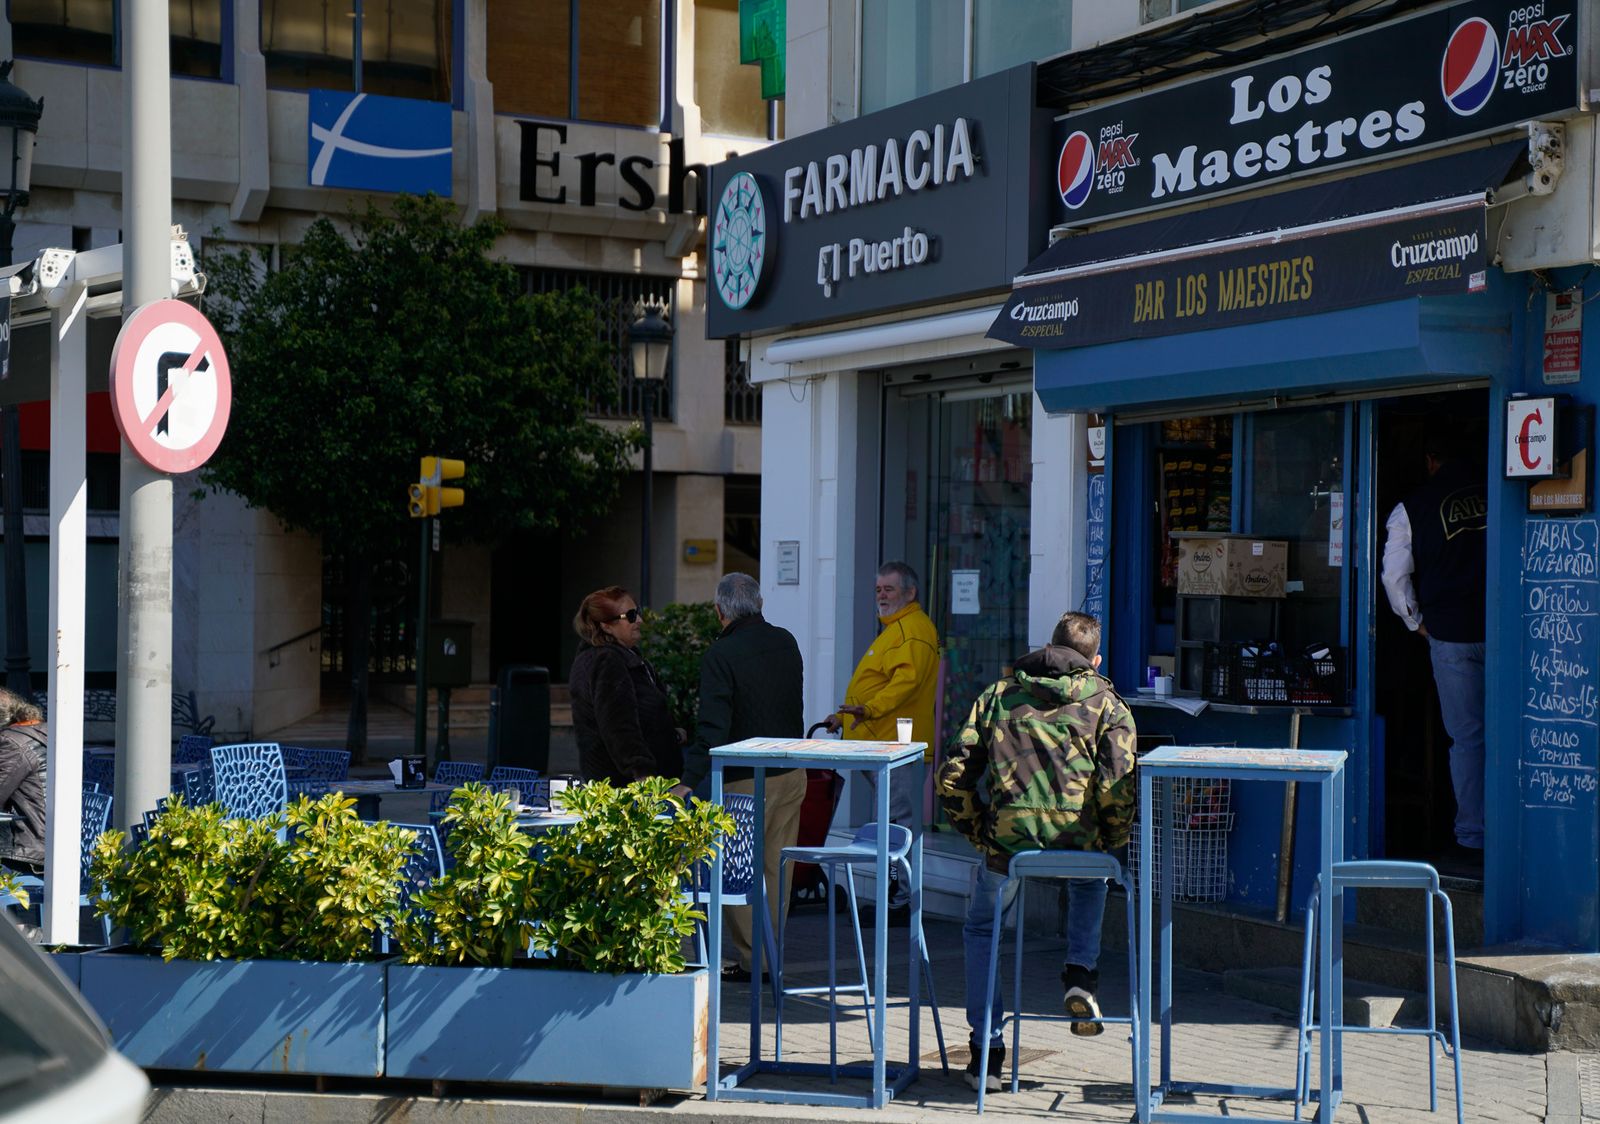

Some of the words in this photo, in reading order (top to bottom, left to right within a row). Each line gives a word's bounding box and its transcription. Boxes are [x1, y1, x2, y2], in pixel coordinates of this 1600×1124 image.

[1509, 0, 1545, 27] pepsi
[1501, 13, 1572, 69] MAX
[1503, 63, 1549, 90] zero
[1521, 82, 1547, 94] azúcar
[1230, 64, 1333, 126] Los
[1100, 120, 1124, 141] pepsi
[1096, 133, 1140, 174] MAX
[1151, 100, 1427, 199] Maestres
[784, 117, 975, 224] FARMACIA
[1097, 171, 1126, 190] zero
[849, 226, 929, 277] Puerto
[1391, 229, 1479, 269] Cruzcampo
[1404, 262, 1462, 285] ESPECIAL
[1133, 279, 1166, 324] BAR
[1175, 272, 1208, 319] LOS
[1217, 254, 1315, 313] MAESTRES
[1010, 297, 1079, 322] Cruzcampo
[1020, 323, 1065, 337] ESPECIAL
[1546, 334, 1579, 346] Alarma
[1532, 495, 1543, 505] BAR
[1554, 493, 1583, 505] MAESTRES
[1528, 521, 1585, 553] HABAS
